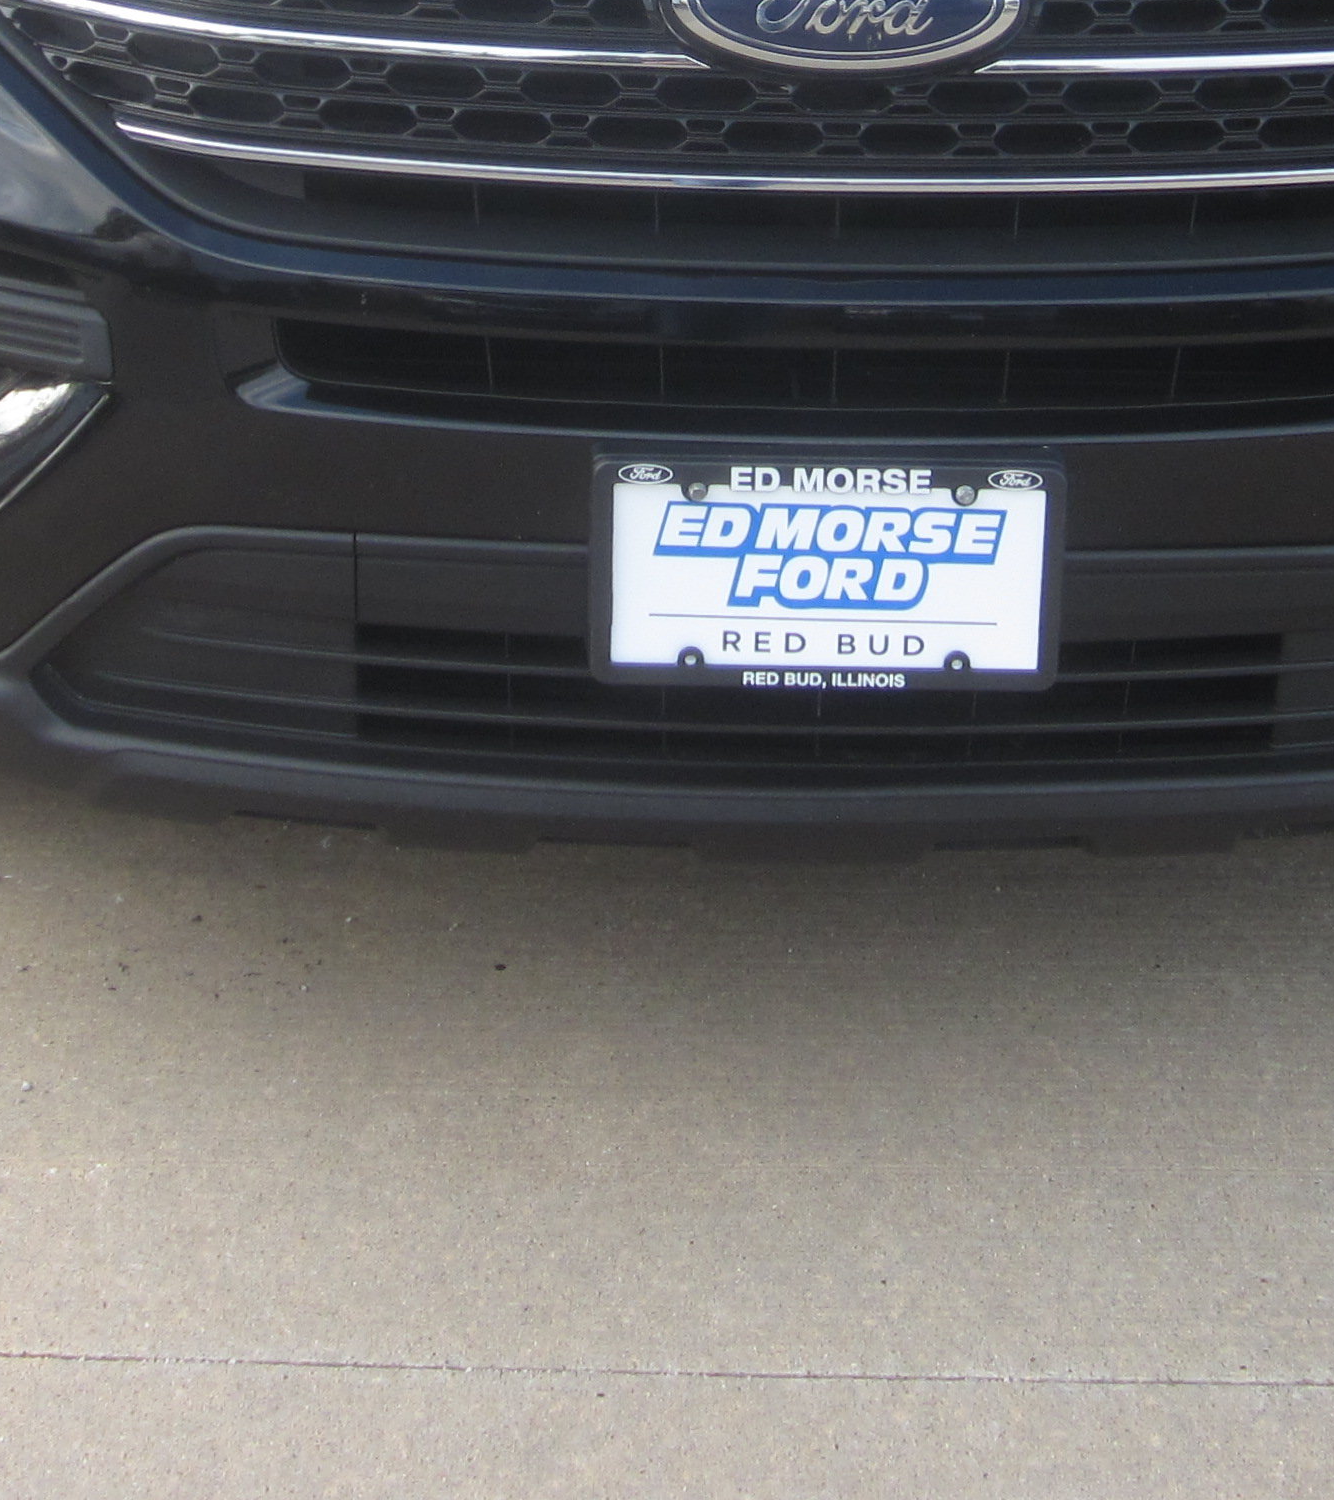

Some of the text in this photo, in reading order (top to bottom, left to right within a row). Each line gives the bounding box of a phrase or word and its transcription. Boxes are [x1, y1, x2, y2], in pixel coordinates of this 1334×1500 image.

[629, 466, 663, 481] Ford
[730, 466, 932, 494] ED MORSE
[999, 471, 1032, 487] Ford
[656, 502, 1003, 556] ED MORSE
[731, 553, 927, 605] FORD
[722, 630, 925, 656] RED BUD
[742, 671, 906, 689] RED BUD, ILLINOIS
